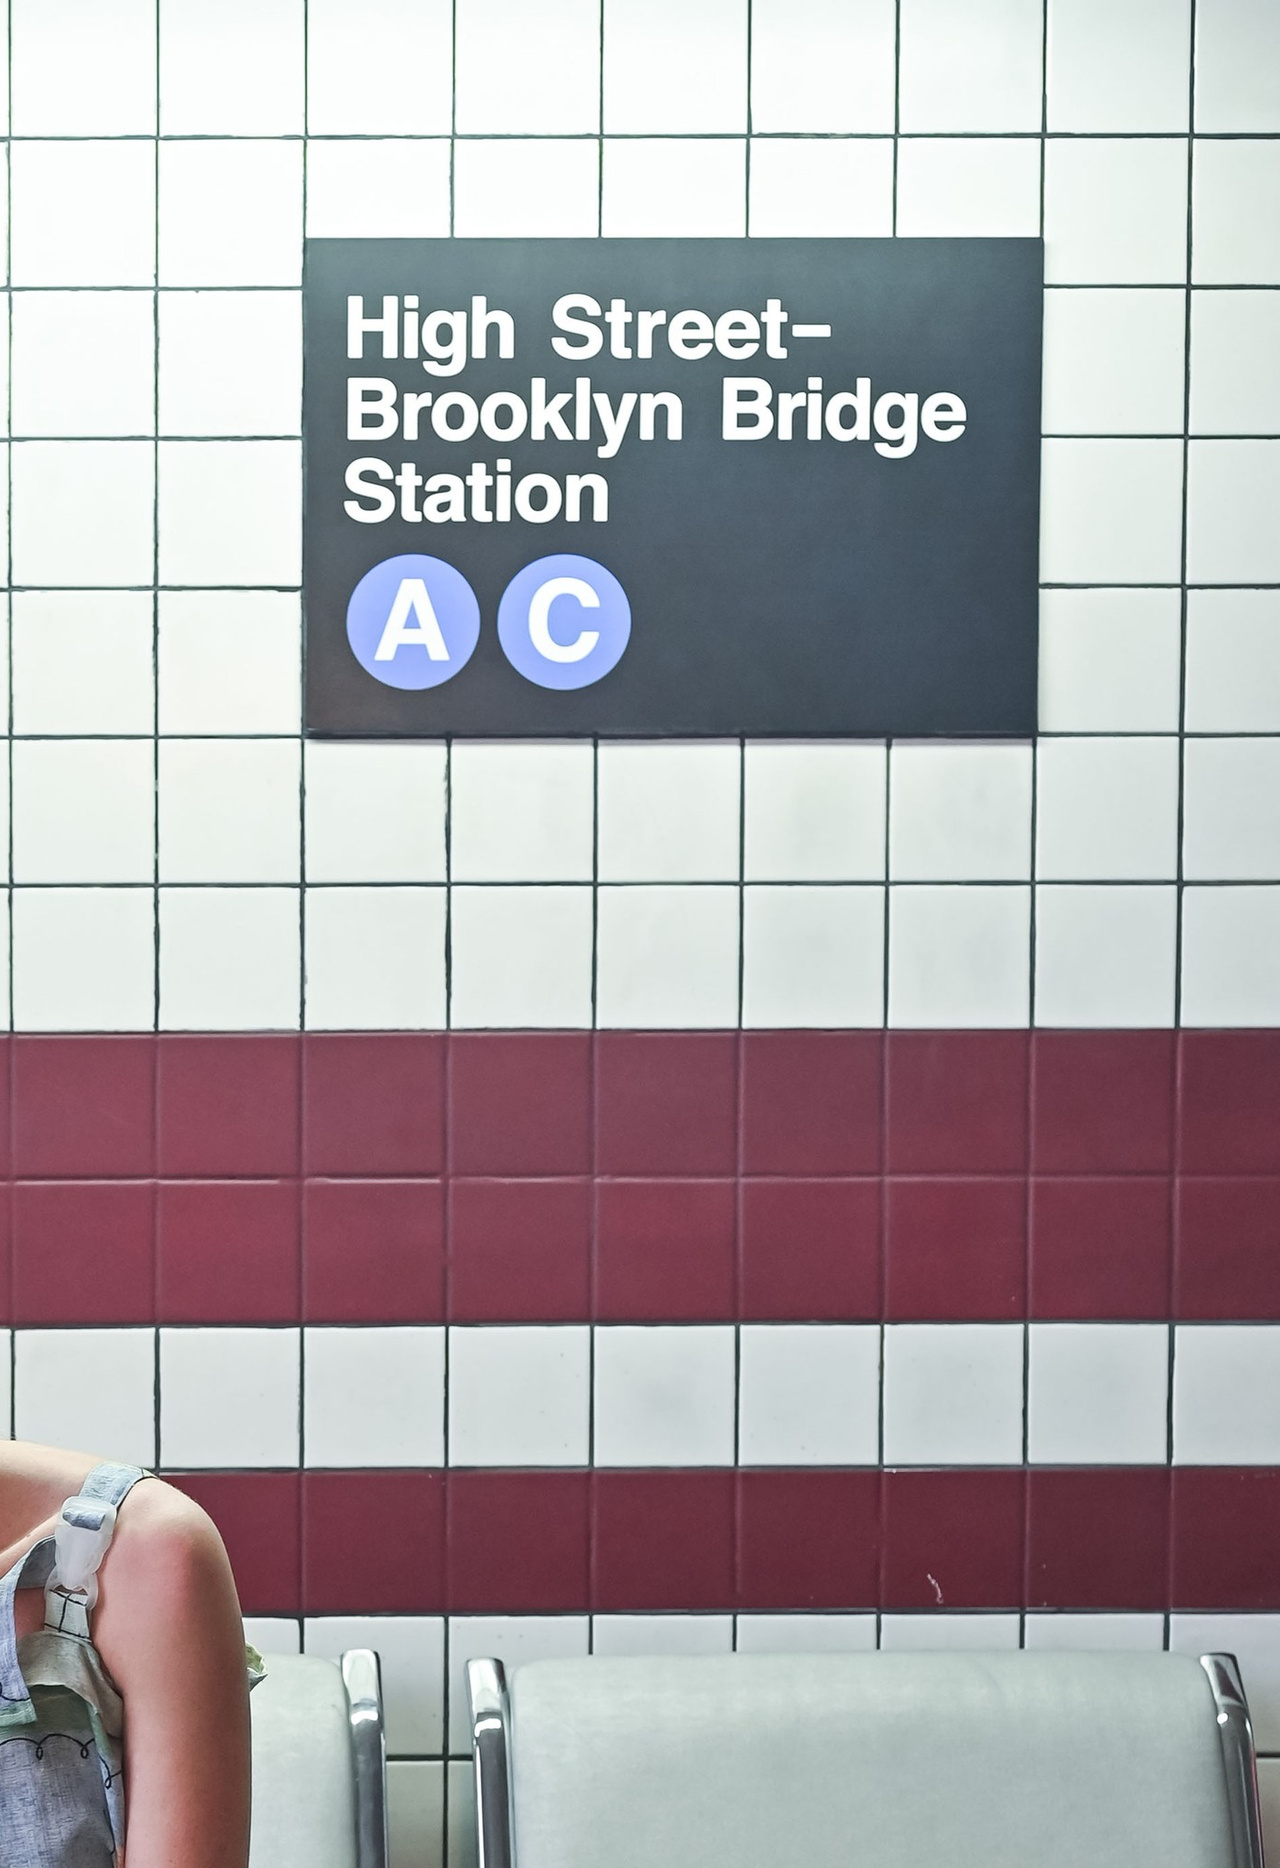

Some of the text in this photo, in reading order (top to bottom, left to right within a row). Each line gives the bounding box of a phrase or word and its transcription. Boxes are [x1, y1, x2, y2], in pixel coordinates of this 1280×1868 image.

[347, 295, 516, 377] High
[346, 376, 968, 459] Brooklyn Bridge
[343, 457, 609, 524] Station
[373, 577, 601, 664] A C
